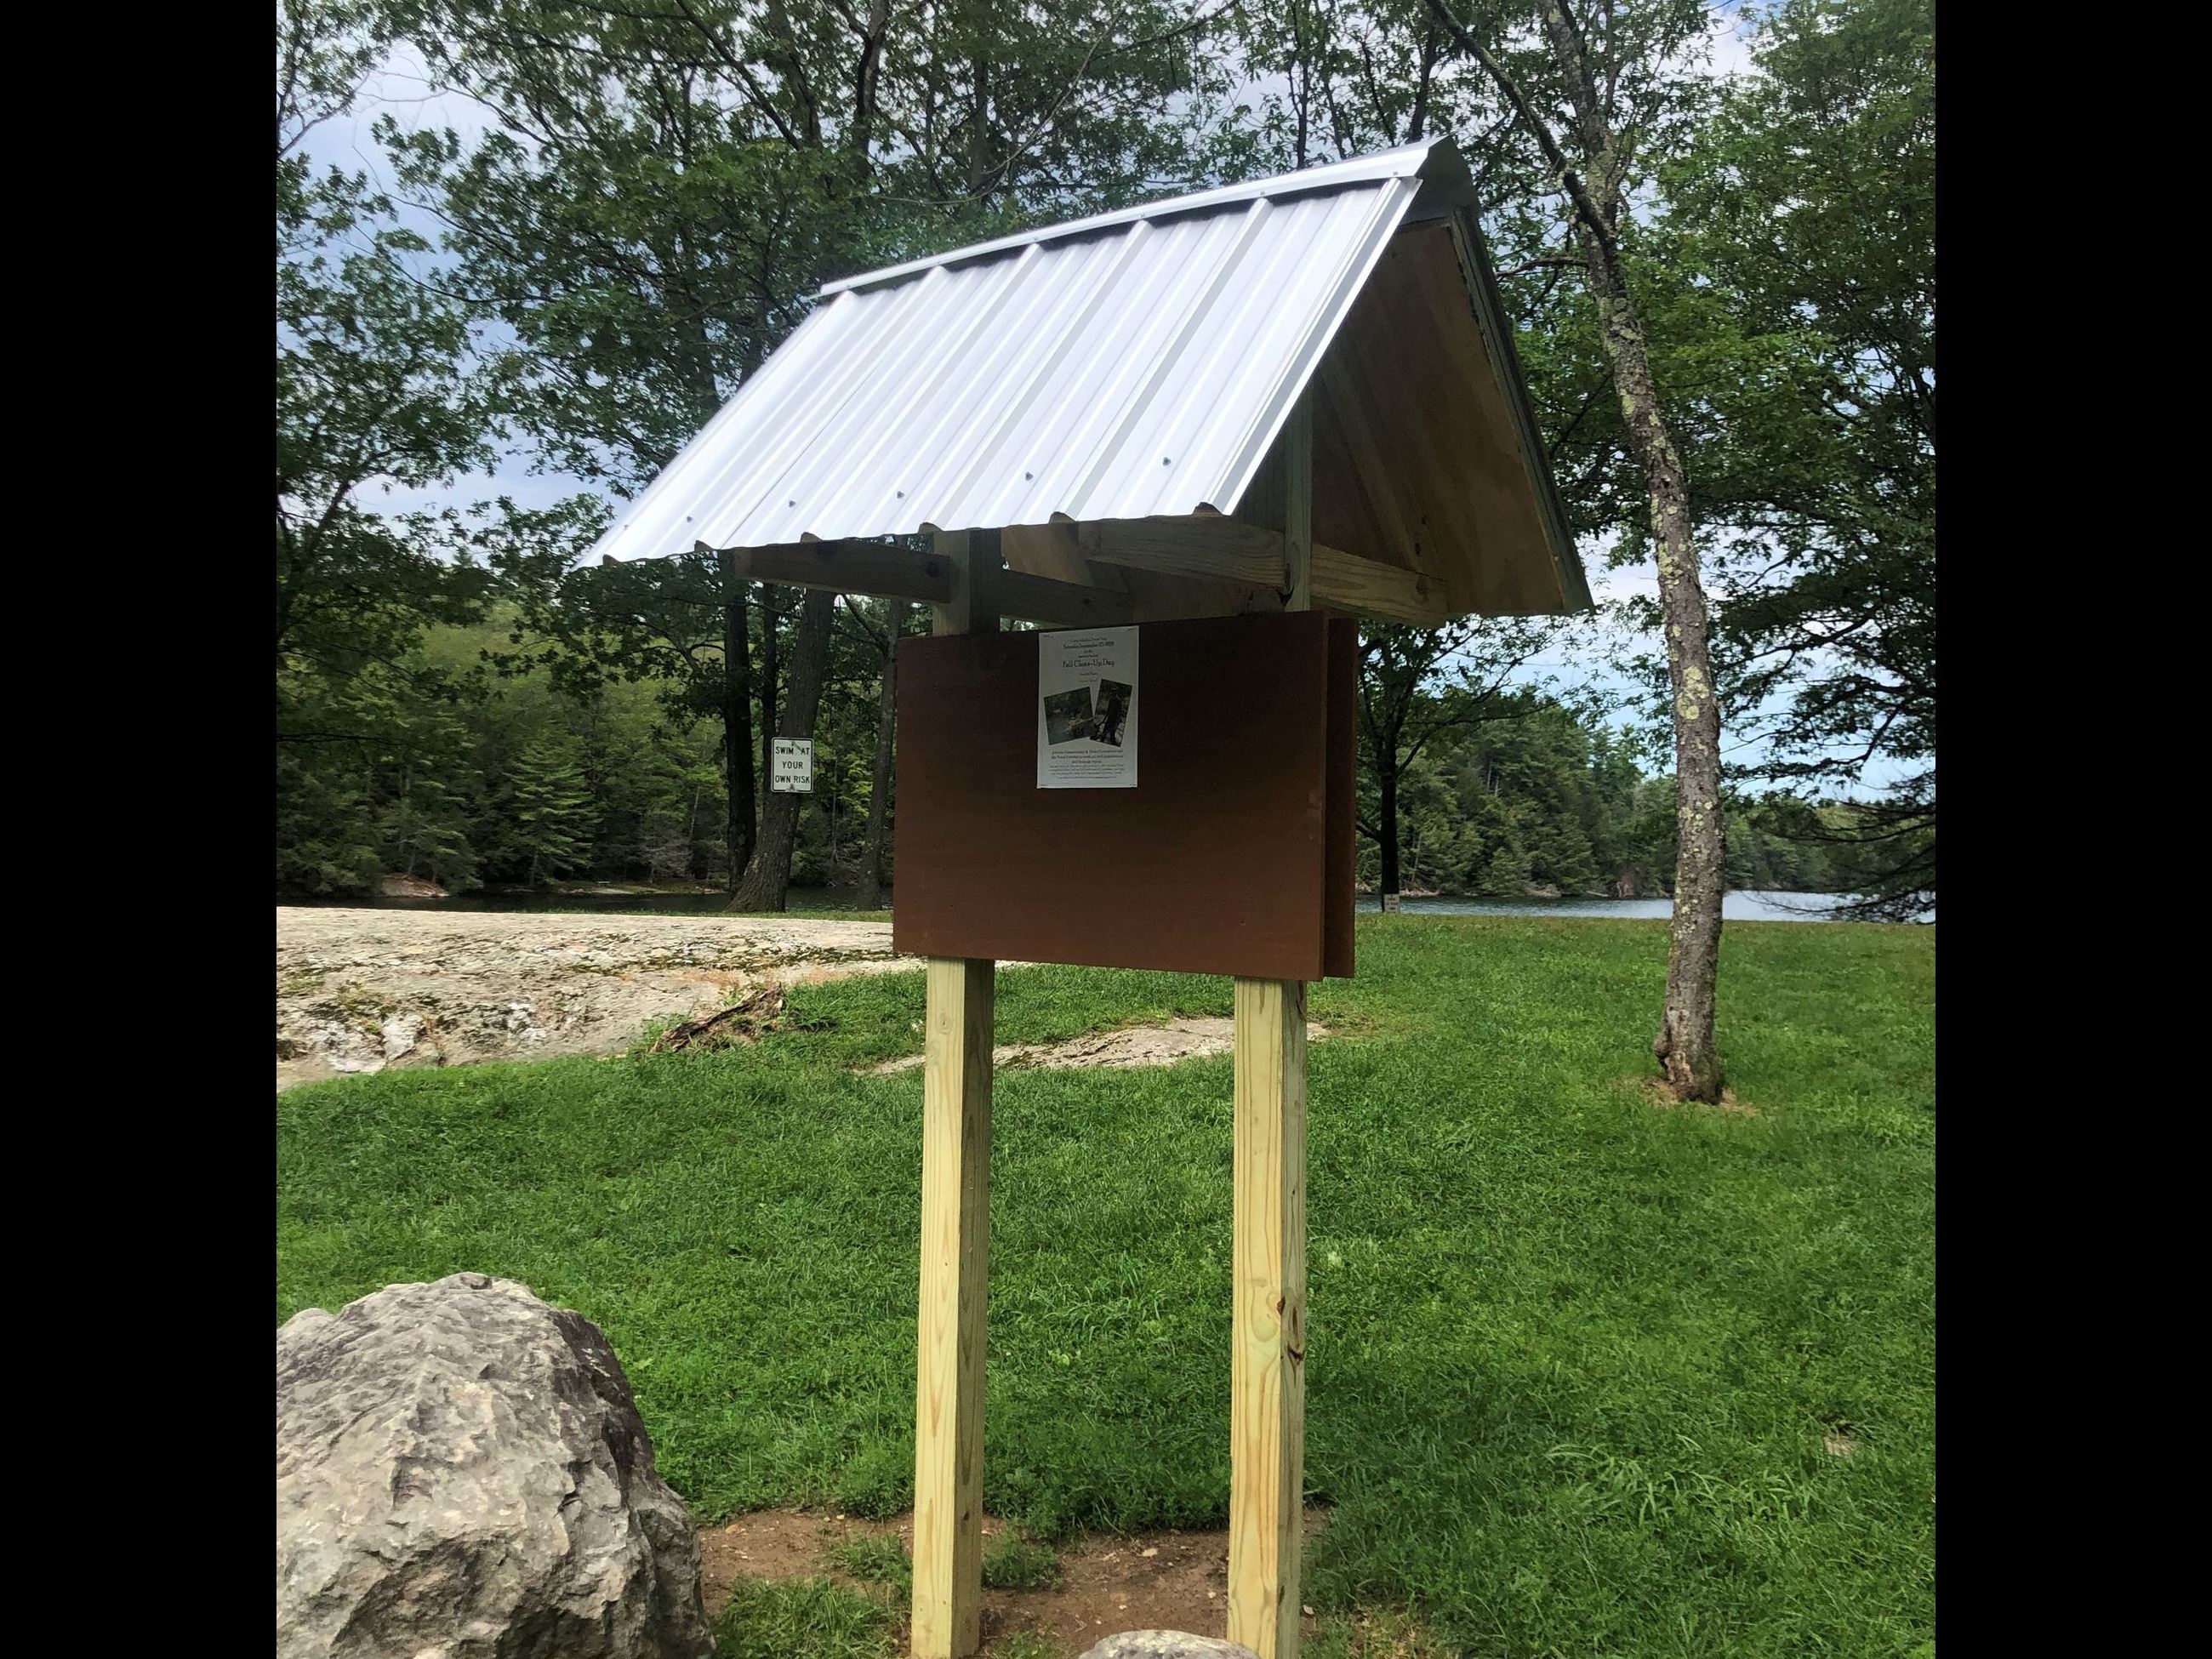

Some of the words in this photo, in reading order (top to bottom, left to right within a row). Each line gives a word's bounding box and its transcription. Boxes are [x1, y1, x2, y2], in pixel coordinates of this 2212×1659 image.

[775, 746, 794, 755] SWIM
[801, 747, 810, 755] AT
[793, 775, 810, 784] RISK
